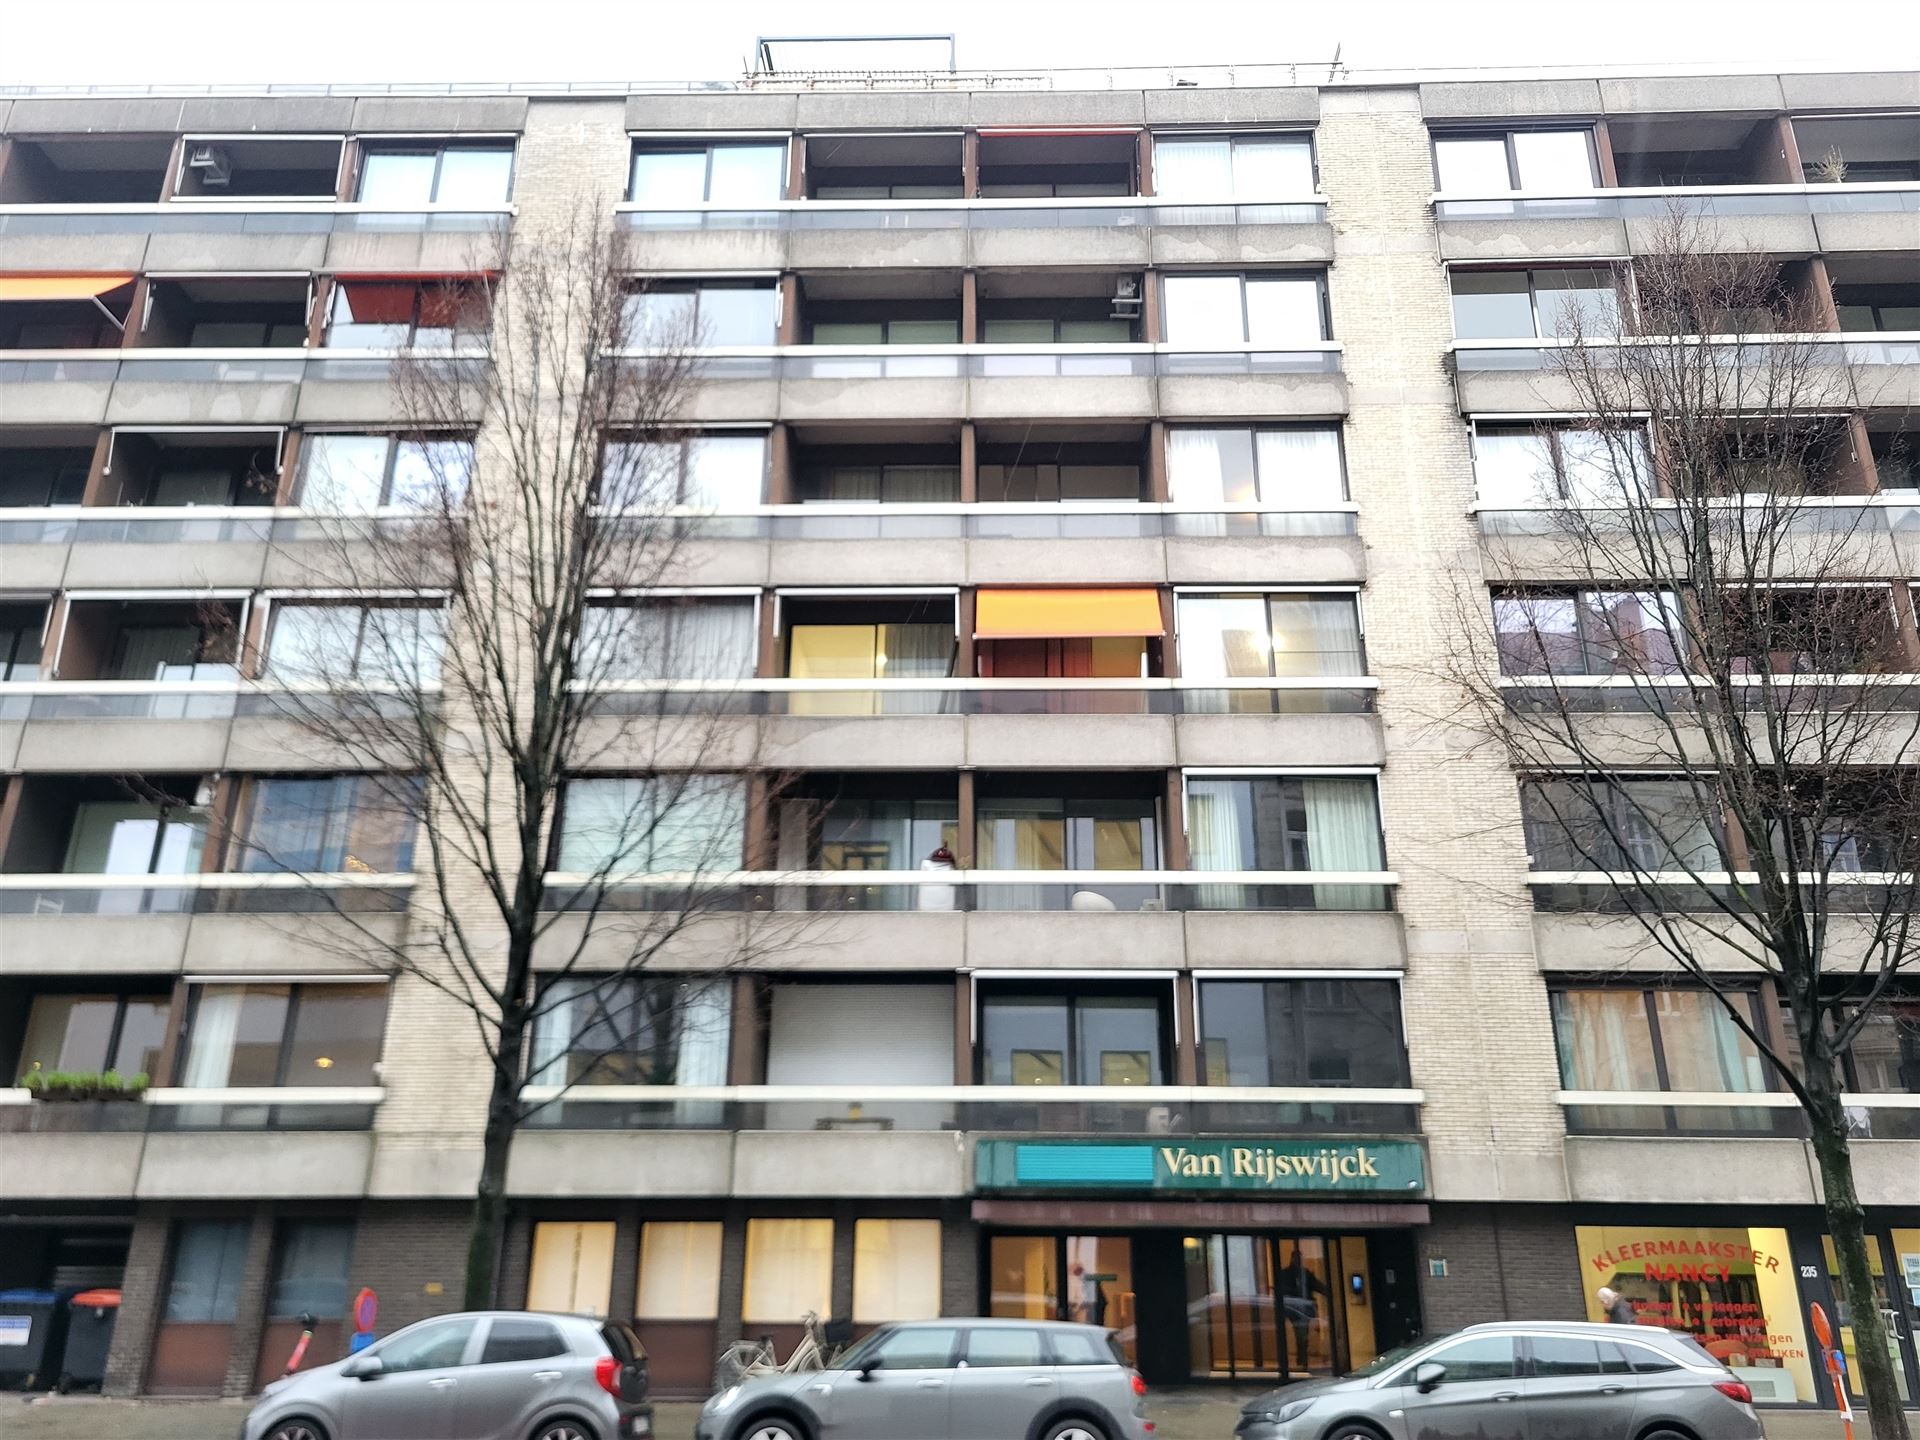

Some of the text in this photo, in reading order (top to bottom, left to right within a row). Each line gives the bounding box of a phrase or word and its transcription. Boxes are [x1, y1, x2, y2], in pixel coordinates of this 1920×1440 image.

[1160, 1147, 1379, 1183] Van Rijswijck
[1592, 1240, 1780, 1274] KLEERMAAKSTER
[1644, 1263, 1731, 1283] NANCY
[1800, 1265, 1818, 1278] 235
